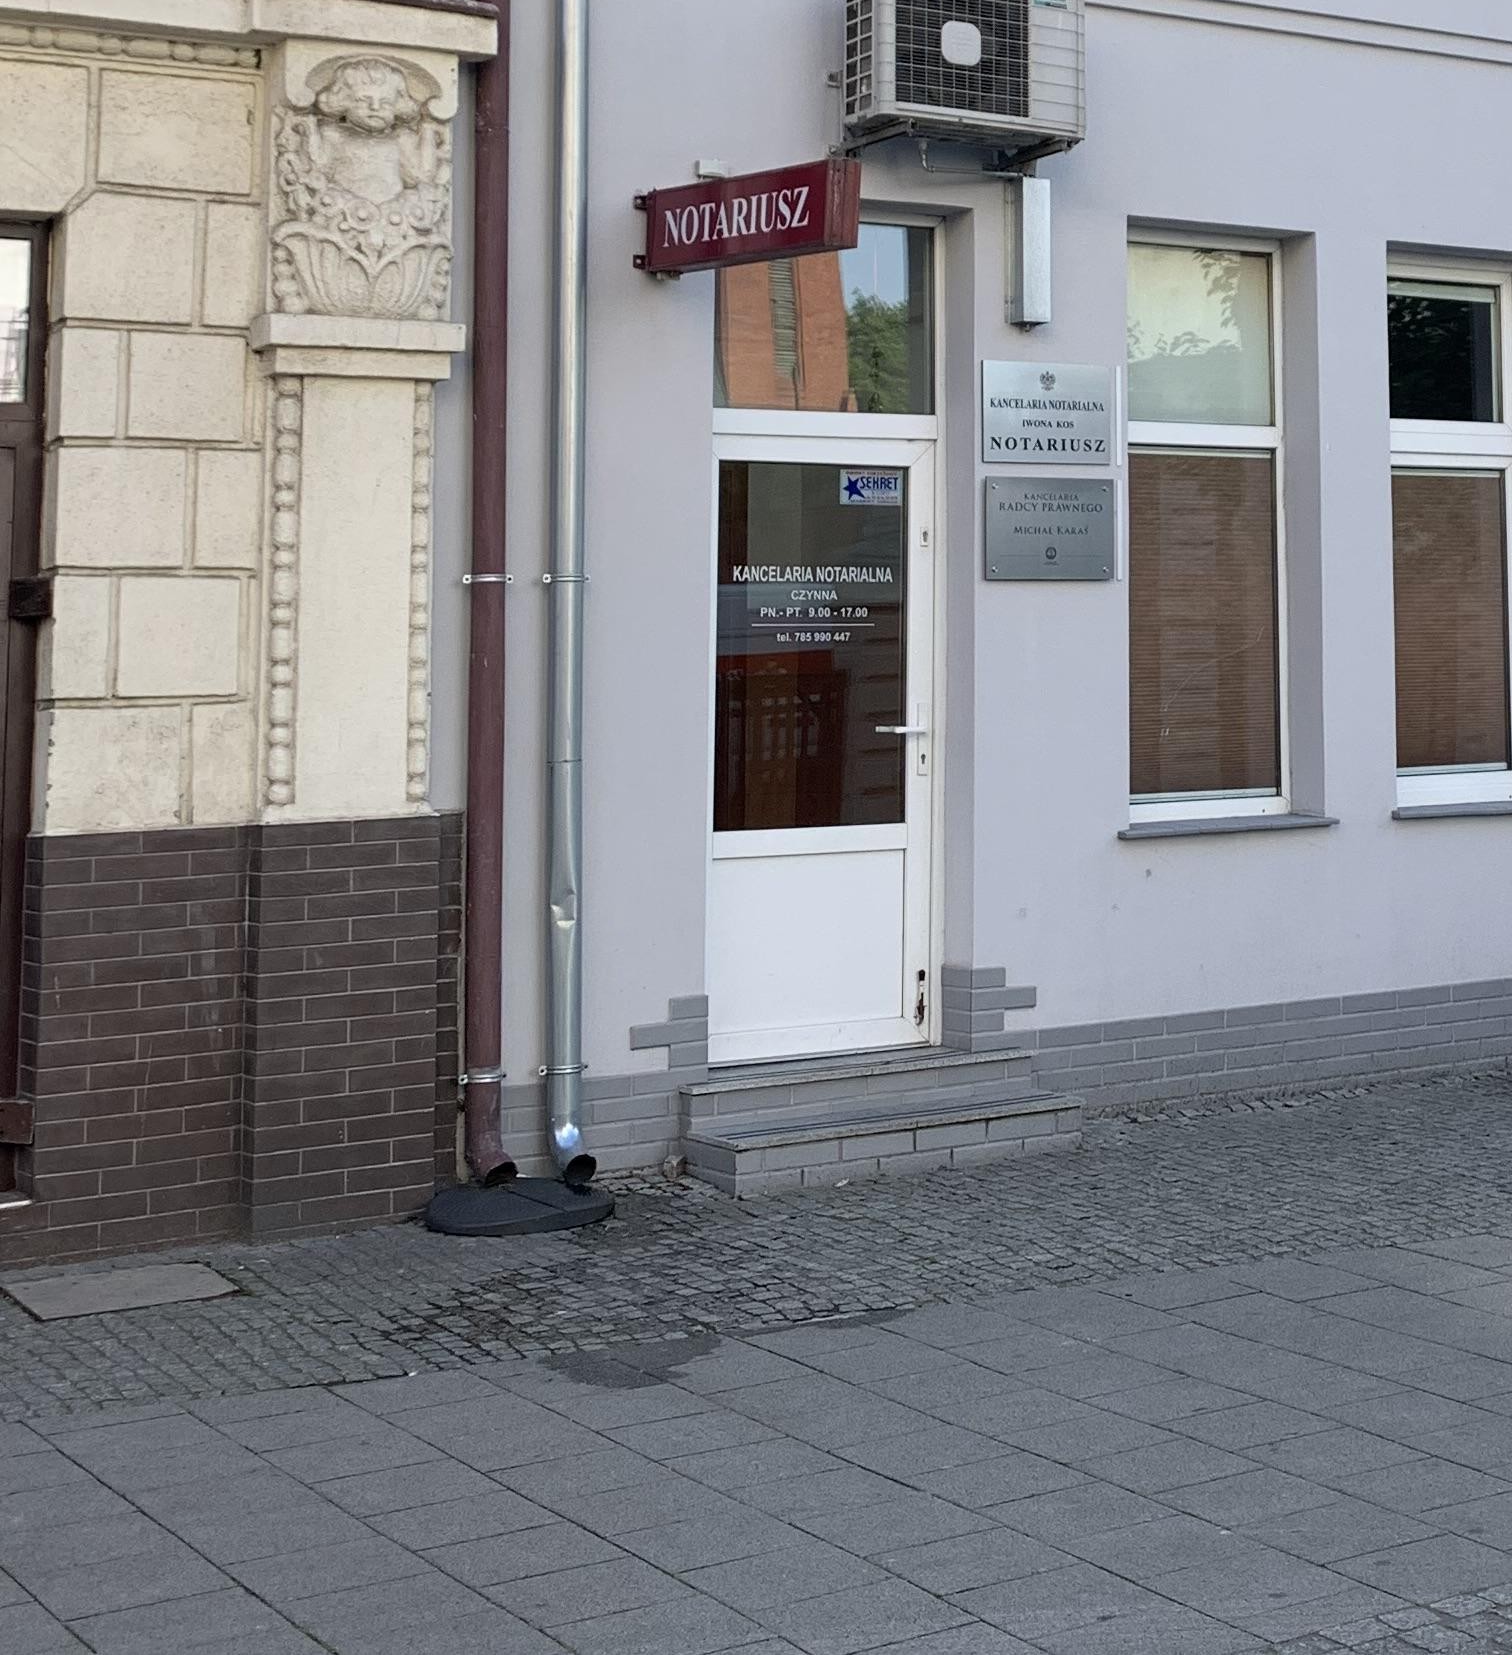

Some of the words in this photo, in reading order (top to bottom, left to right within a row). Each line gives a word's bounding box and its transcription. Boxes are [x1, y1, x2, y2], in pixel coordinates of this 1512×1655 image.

[663, 186, 810, 248] NOTARIUSZ
[990, 398, 1048, 411] KANCELARIA
[1048, 400, 1105, 412] NOTARIALNA
[1022, 419, 1053, 429] IWONA
[1056, 420, 1075, 429] KOS
[990, 437, 1106, 453] NOTARIUSZ
[1024, 492, 1080, 502] KANCELARIA
[999, 502, 1039, 512] RADCY
[1042, 503, 1103, 513] PRAWNEGO
[733, 565, 814, 582] KANCELARIA
[816, 566, 893, 583] NOTARIALNA
[791, 590, 838, 601] CZYNNA
[808, 607, 831, 618] 9.00
[840, 607, 868, 618] 17.00
[777, 632, 792, 642] tel.
[814, 632, 832, 642] 990
[833, 632, 851, 642] 447
